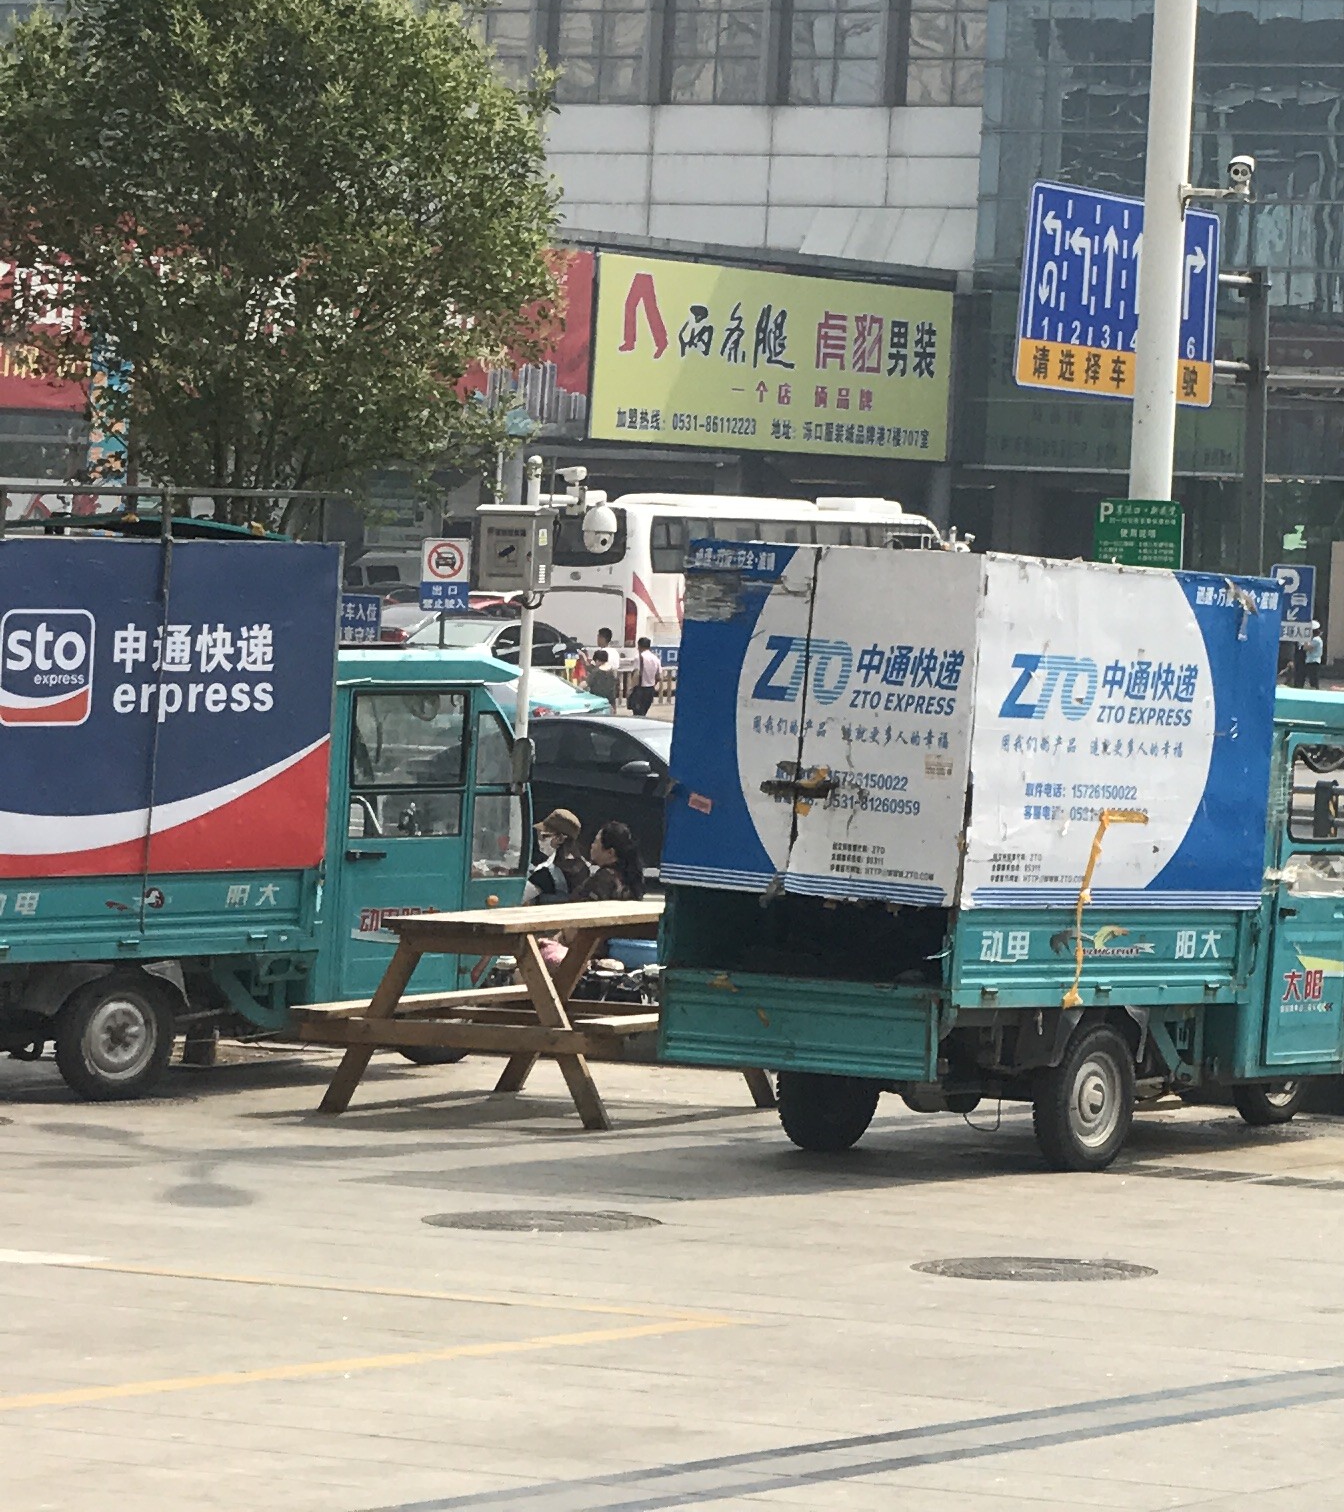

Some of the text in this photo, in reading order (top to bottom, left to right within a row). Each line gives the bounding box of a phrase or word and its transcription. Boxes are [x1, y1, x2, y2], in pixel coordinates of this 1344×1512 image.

[678, 301, 938, 379] 两条腿 虎豹男装
[1041, 316, 1050, 341] 1
[1070, 320, 1082, 345] 2
[1100, 324, 1111, 349] 3
[1186, 336, 1196, 359] 6
[1032, 344, 1198, 399] 请选择车驶
[731, 380, 792, 406] 一个店
[422, 597, 466, 610] 禁止驶入
[432, 585, 458, 596] 出口
[6, 622, 86, 671] sto
[113, 623, 275, 673] 申通快递
[856, 643, 966, 692] 中通快递
[34, 671, 85, 687] express
[751, 635, 853, 705] ZTO
[998, 653, 1098, 721] ZTO
[1101, 659, 1199, 703] 中通快递
[112, 681, 275, 722] erpress
[849, 690, 956, 716] ZTO EXPRESS
[1097, 705, 1193, 727] ZTO EXPRESS
[1001, 734, 1077, 756] 用我们的产品
[1282, 968, 1324, 1002] 大阳
